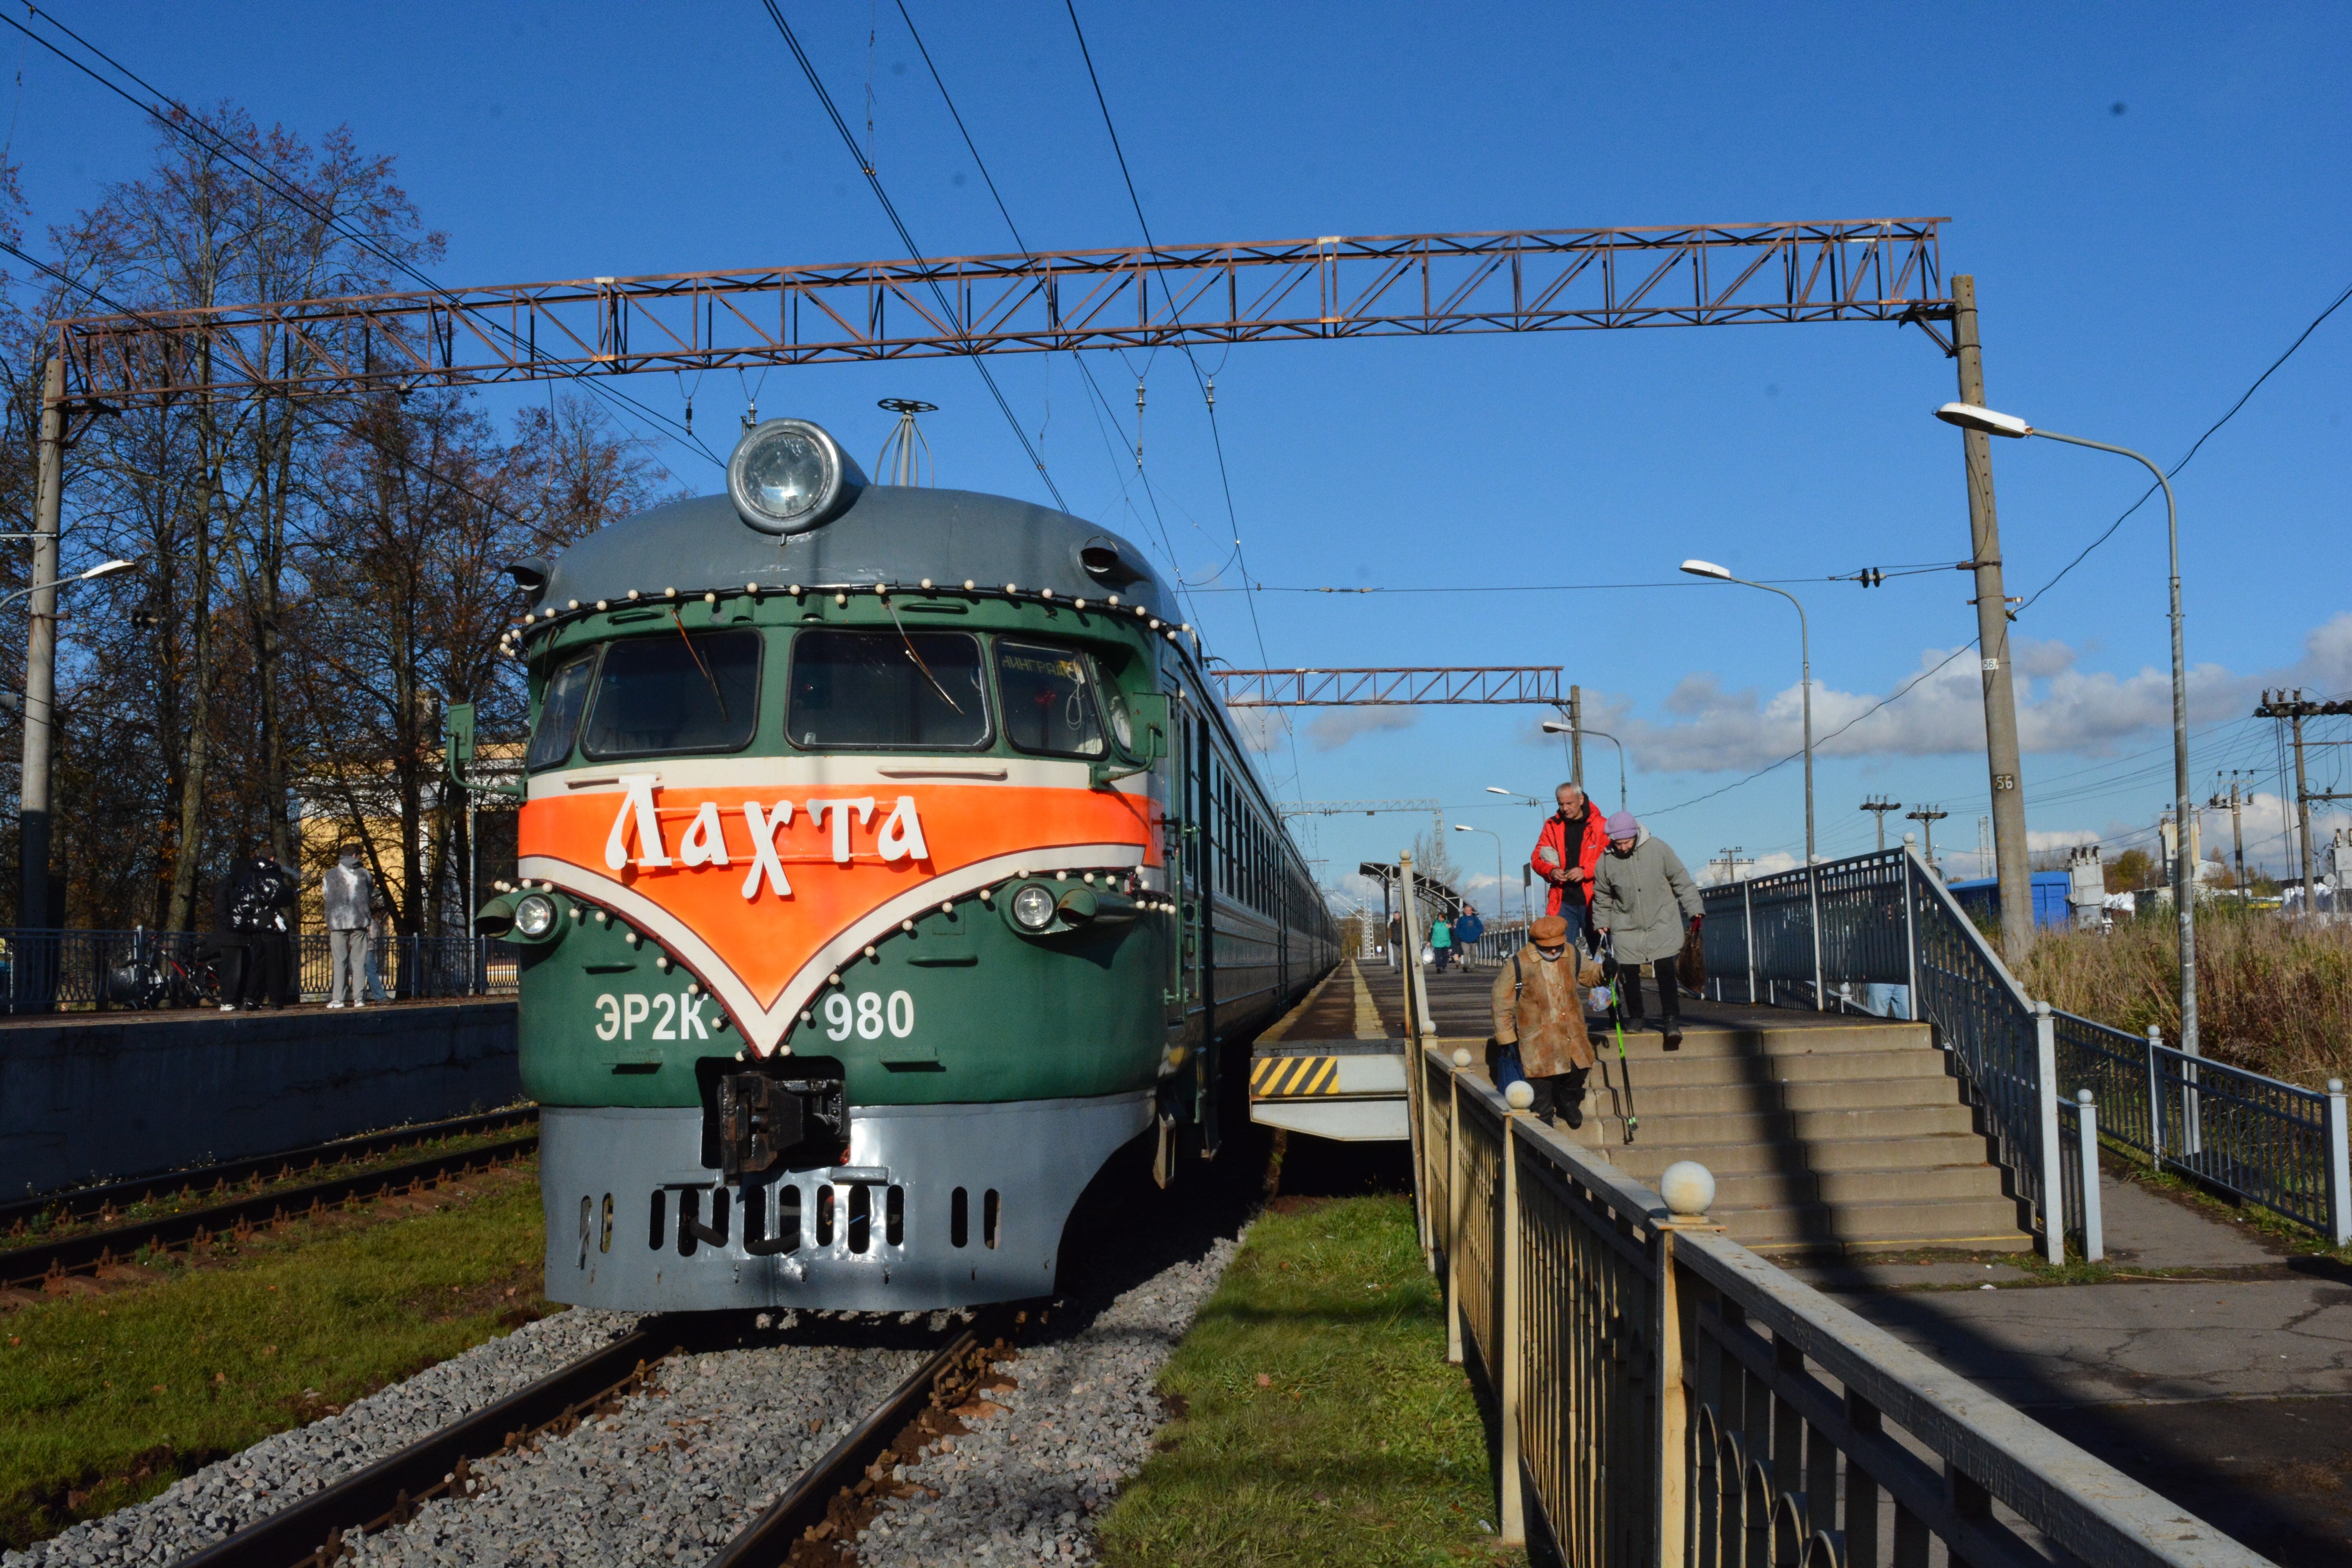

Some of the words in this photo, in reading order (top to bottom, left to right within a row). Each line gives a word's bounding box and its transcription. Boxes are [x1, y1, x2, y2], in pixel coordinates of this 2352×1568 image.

[1984, 660, 1994, 668] 56
[1996, 776, 2013, 789] 56
[605, 773, 929, 899] Лахта
[595, 993, 709, 1041] ЭР2К
[824, 990, 915, 1041] 980
